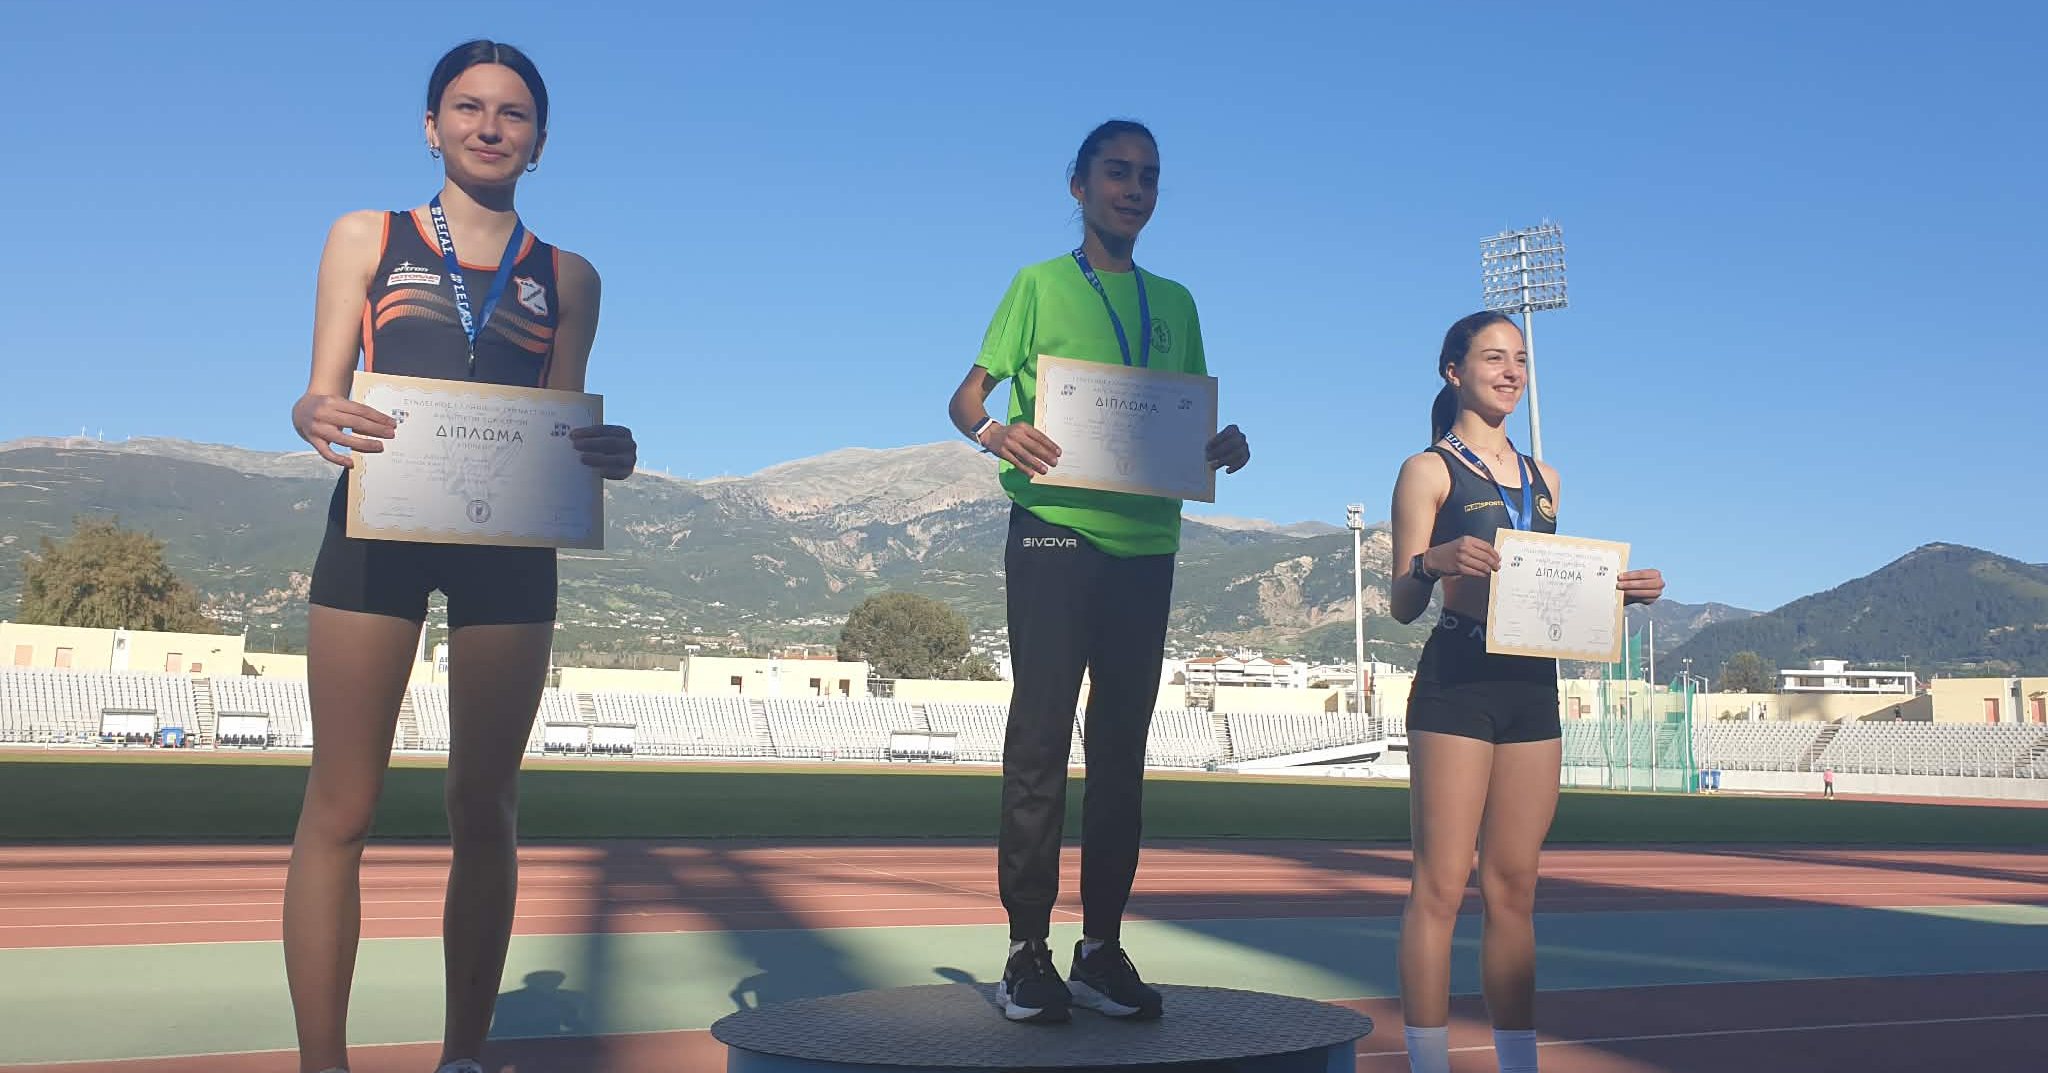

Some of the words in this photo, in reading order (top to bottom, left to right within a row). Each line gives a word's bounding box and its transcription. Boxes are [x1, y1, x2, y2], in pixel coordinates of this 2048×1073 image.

[434, 216, 454, 256] ΣΕΓΑΣ
[1095, 397, 1160, 414] ΔΙΠΛΩΜΑ
[436, 424, 524, 443] ΔΙΠΛΩΜΑ
[1023, 537, 1077, 548] GIVOVA
[1535, 567, 1583, 581] ΔΙΠΛΩΜΑ
